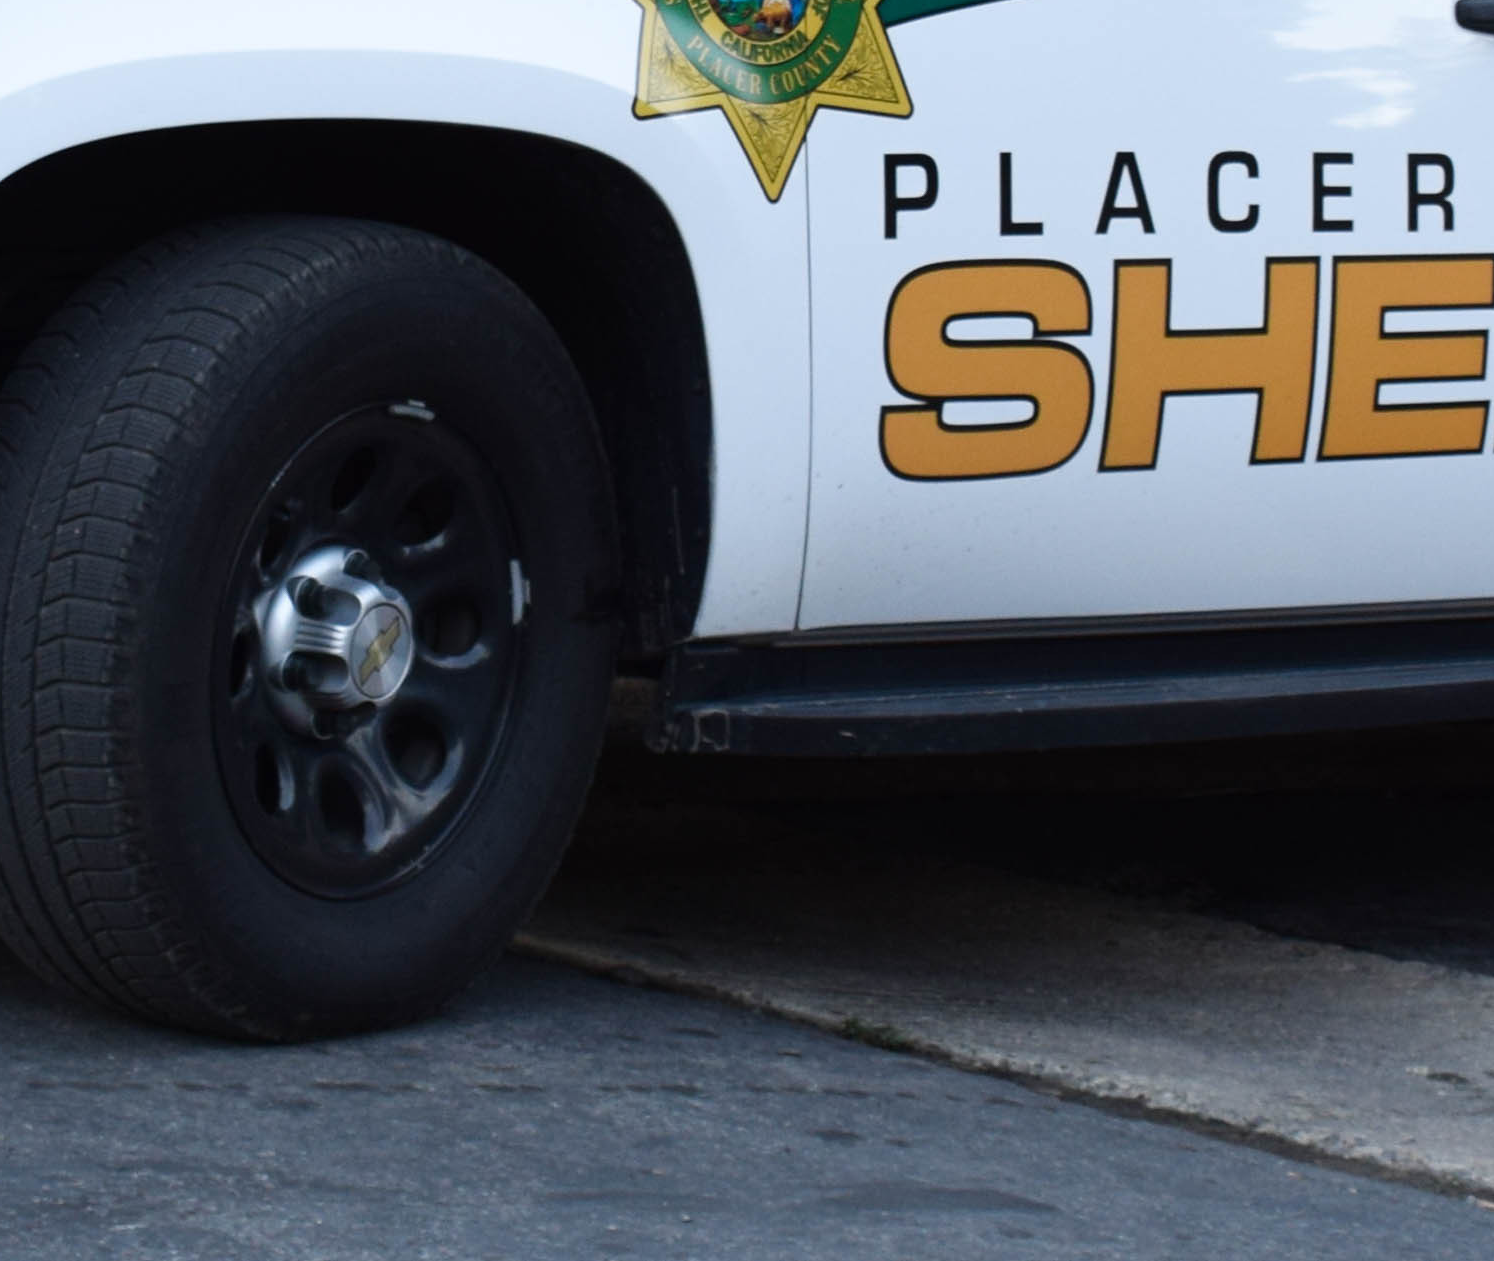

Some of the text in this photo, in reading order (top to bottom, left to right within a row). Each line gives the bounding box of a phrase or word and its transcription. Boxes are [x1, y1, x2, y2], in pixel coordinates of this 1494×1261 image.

[687, 34, 842, 95] PLACER COUNTY
[720, 29, 808, 63] CALIFORNIA
[883, 150, 1455, 239] PLACER
